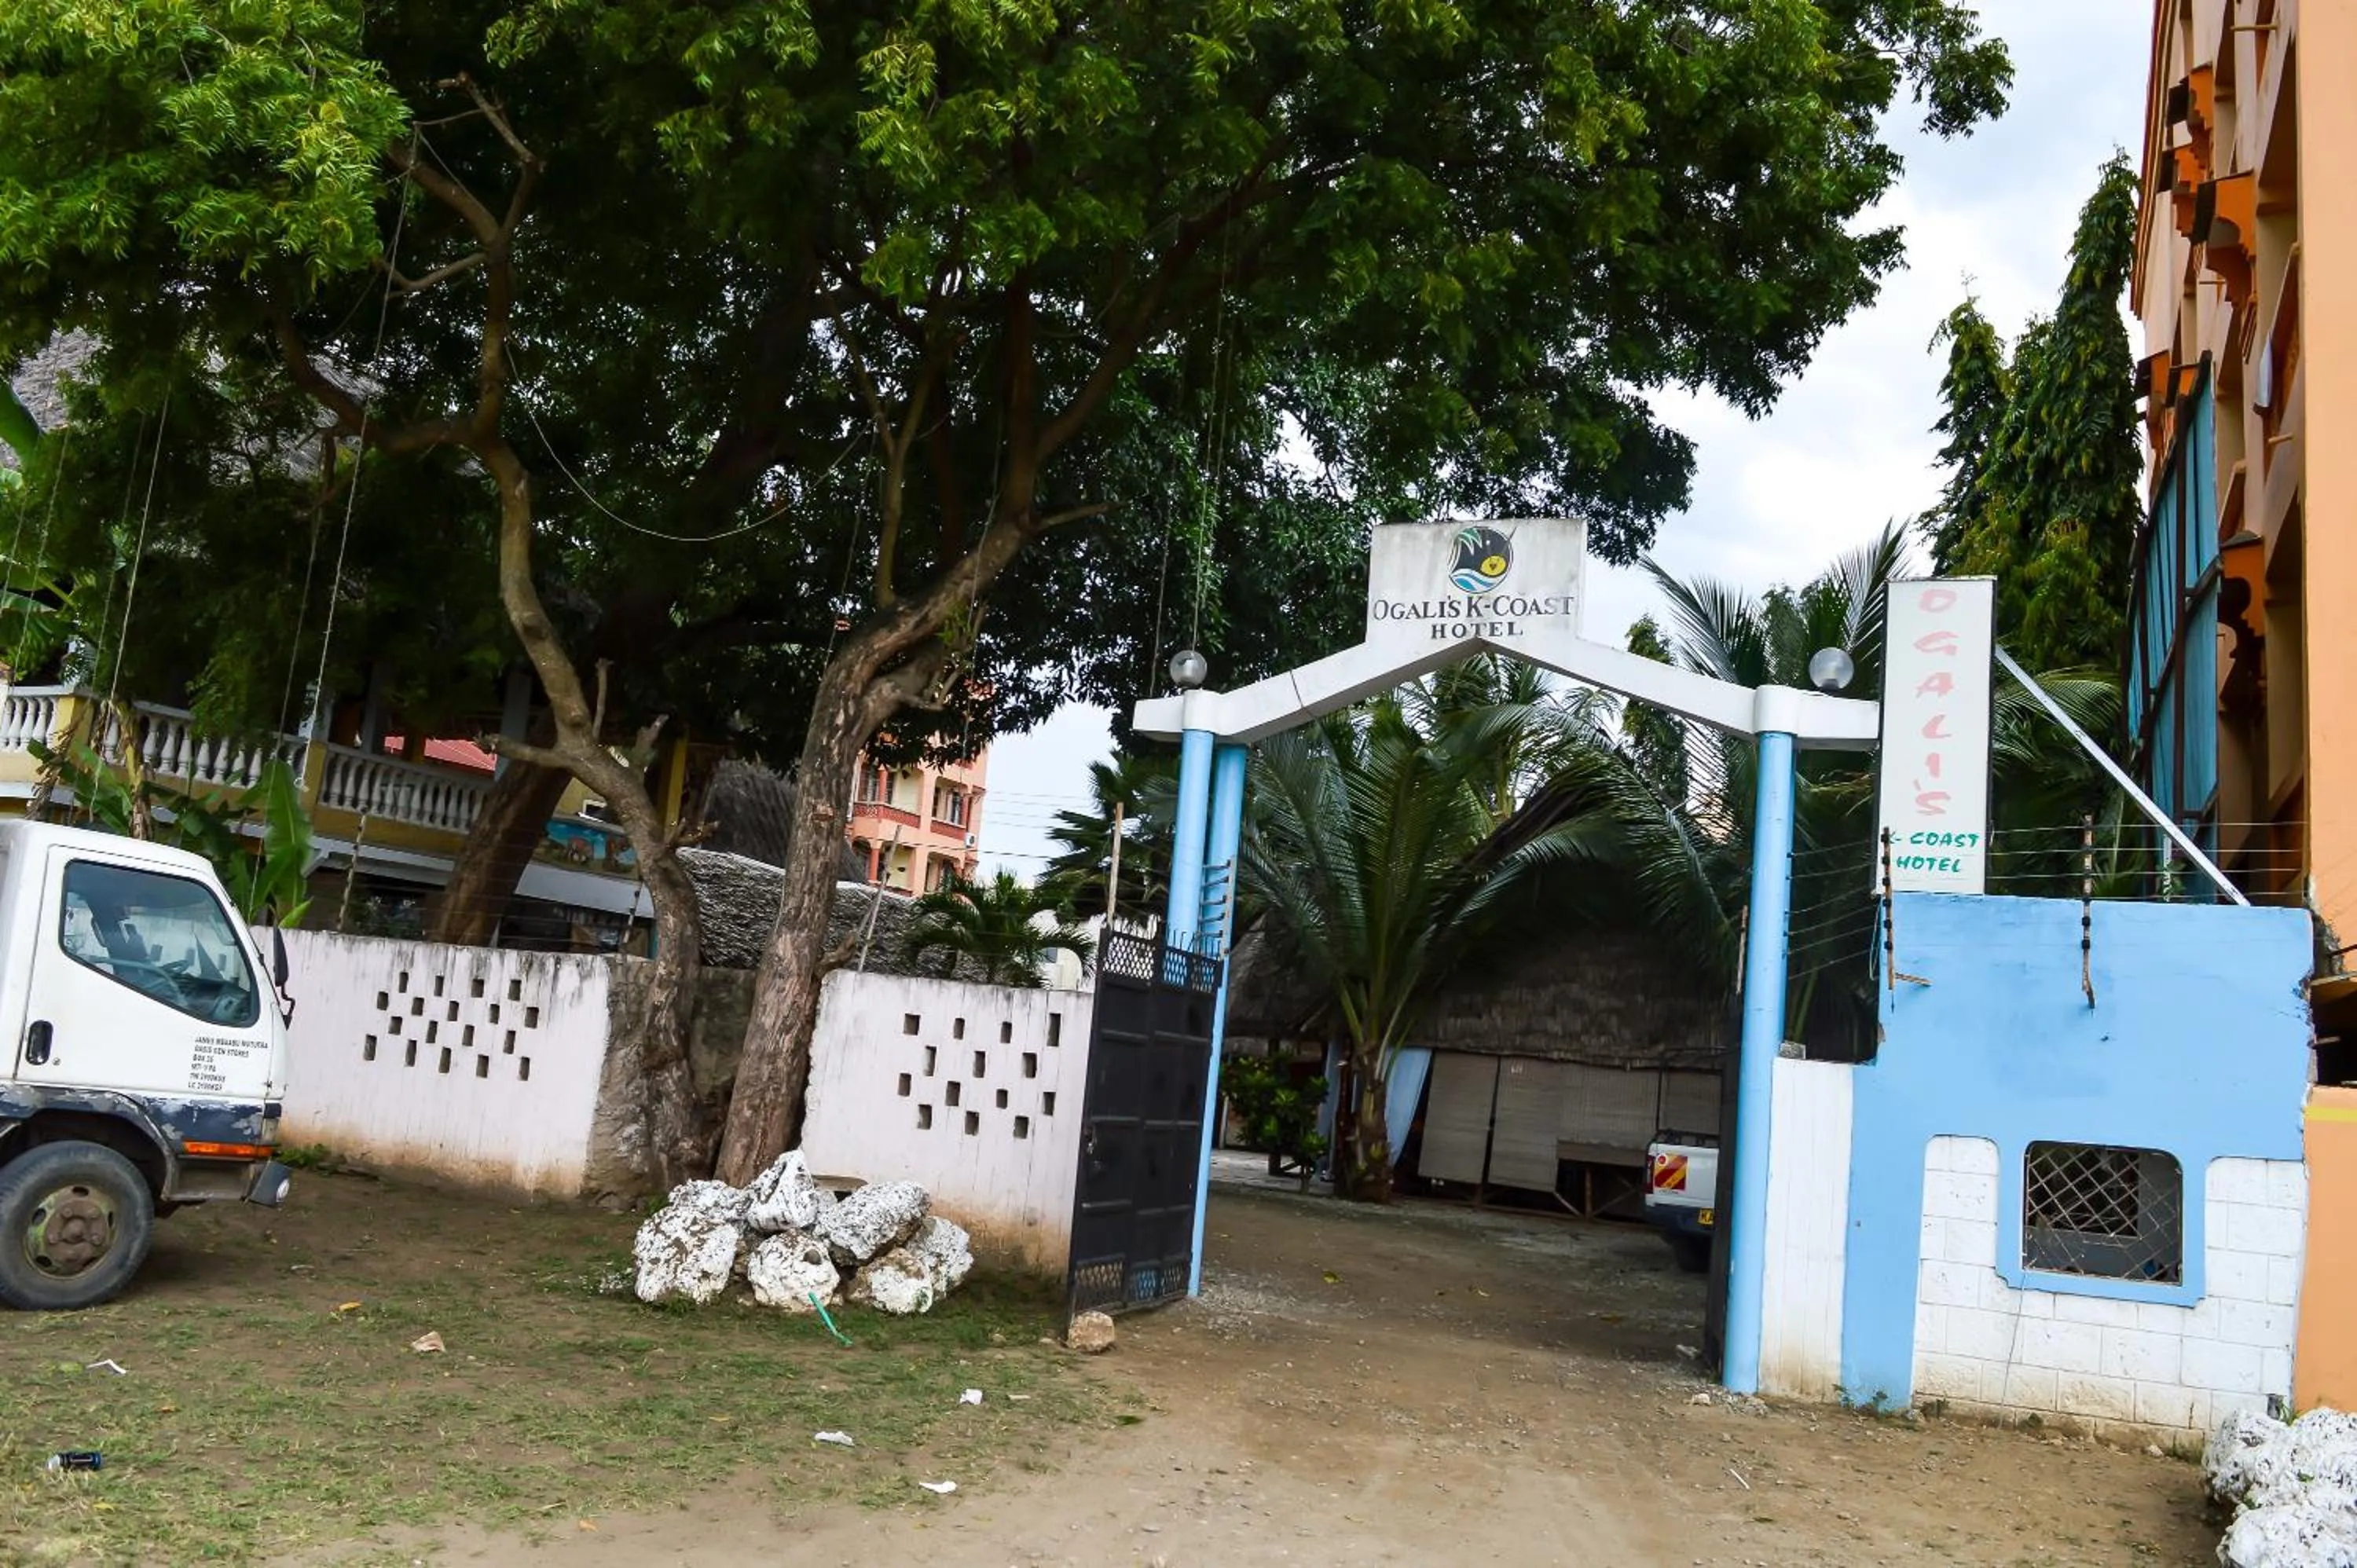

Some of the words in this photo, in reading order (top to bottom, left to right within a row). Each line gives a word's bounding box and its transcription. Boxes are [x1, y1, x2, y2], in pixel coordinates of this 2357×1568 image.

[1373, 595, 1461, 621] OGALI'S
[1467, 594, 1574, 618] K-COAST
[1430, 621, 1524, 639] HOTEL
[1896, 855, 1961, 873] HOTEL
